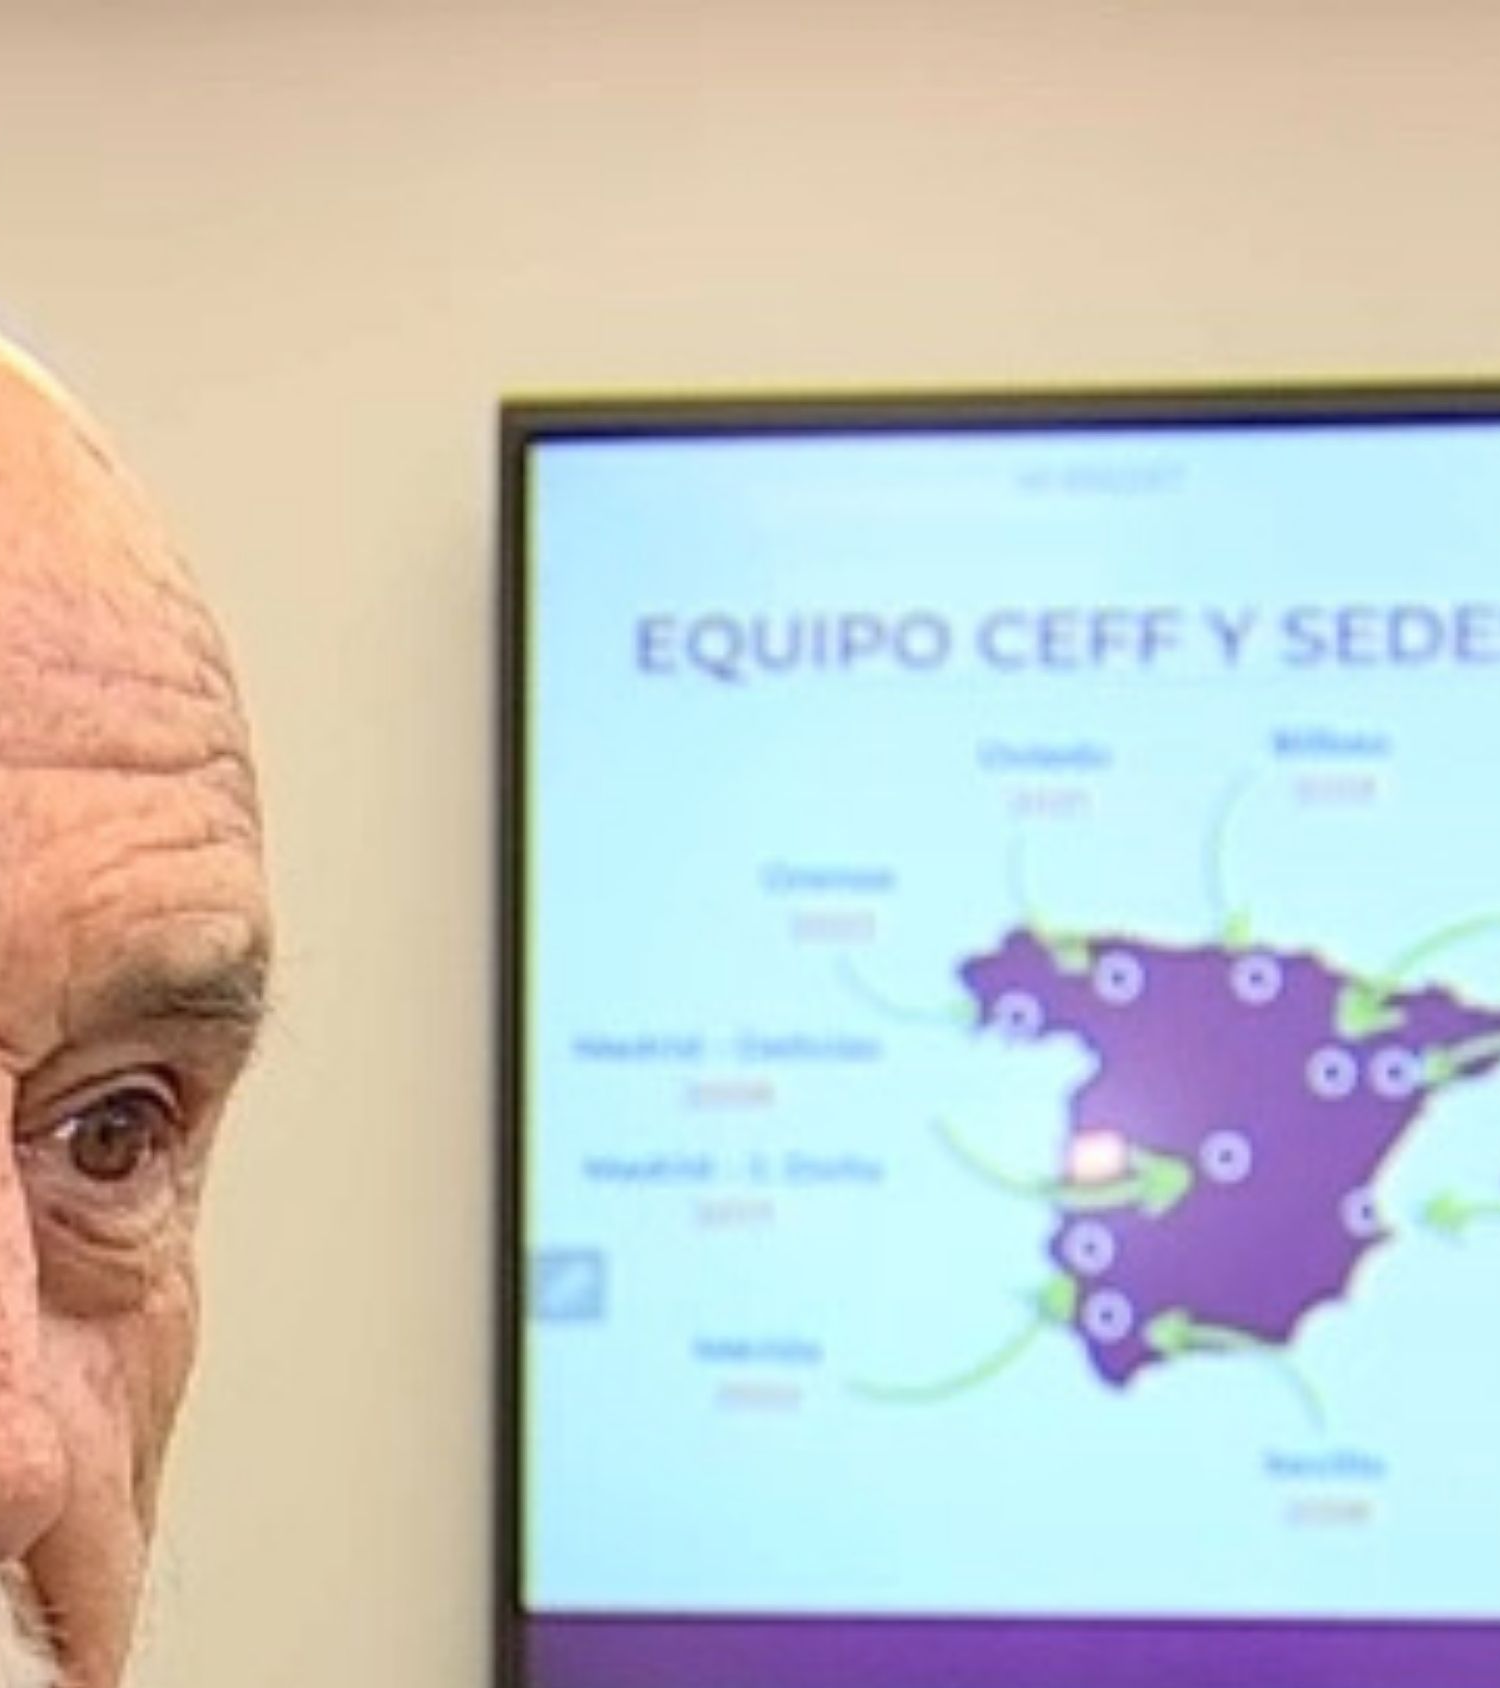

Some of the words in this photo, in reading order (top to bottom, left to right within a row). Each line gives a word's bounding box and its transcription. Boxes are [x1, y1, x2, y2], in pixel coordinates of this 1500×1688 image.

[632, 610, 952, 687] EQUIPO
[974, 606, 1182, 675] CEFF
[1206, 606, 1256, 669] Y
